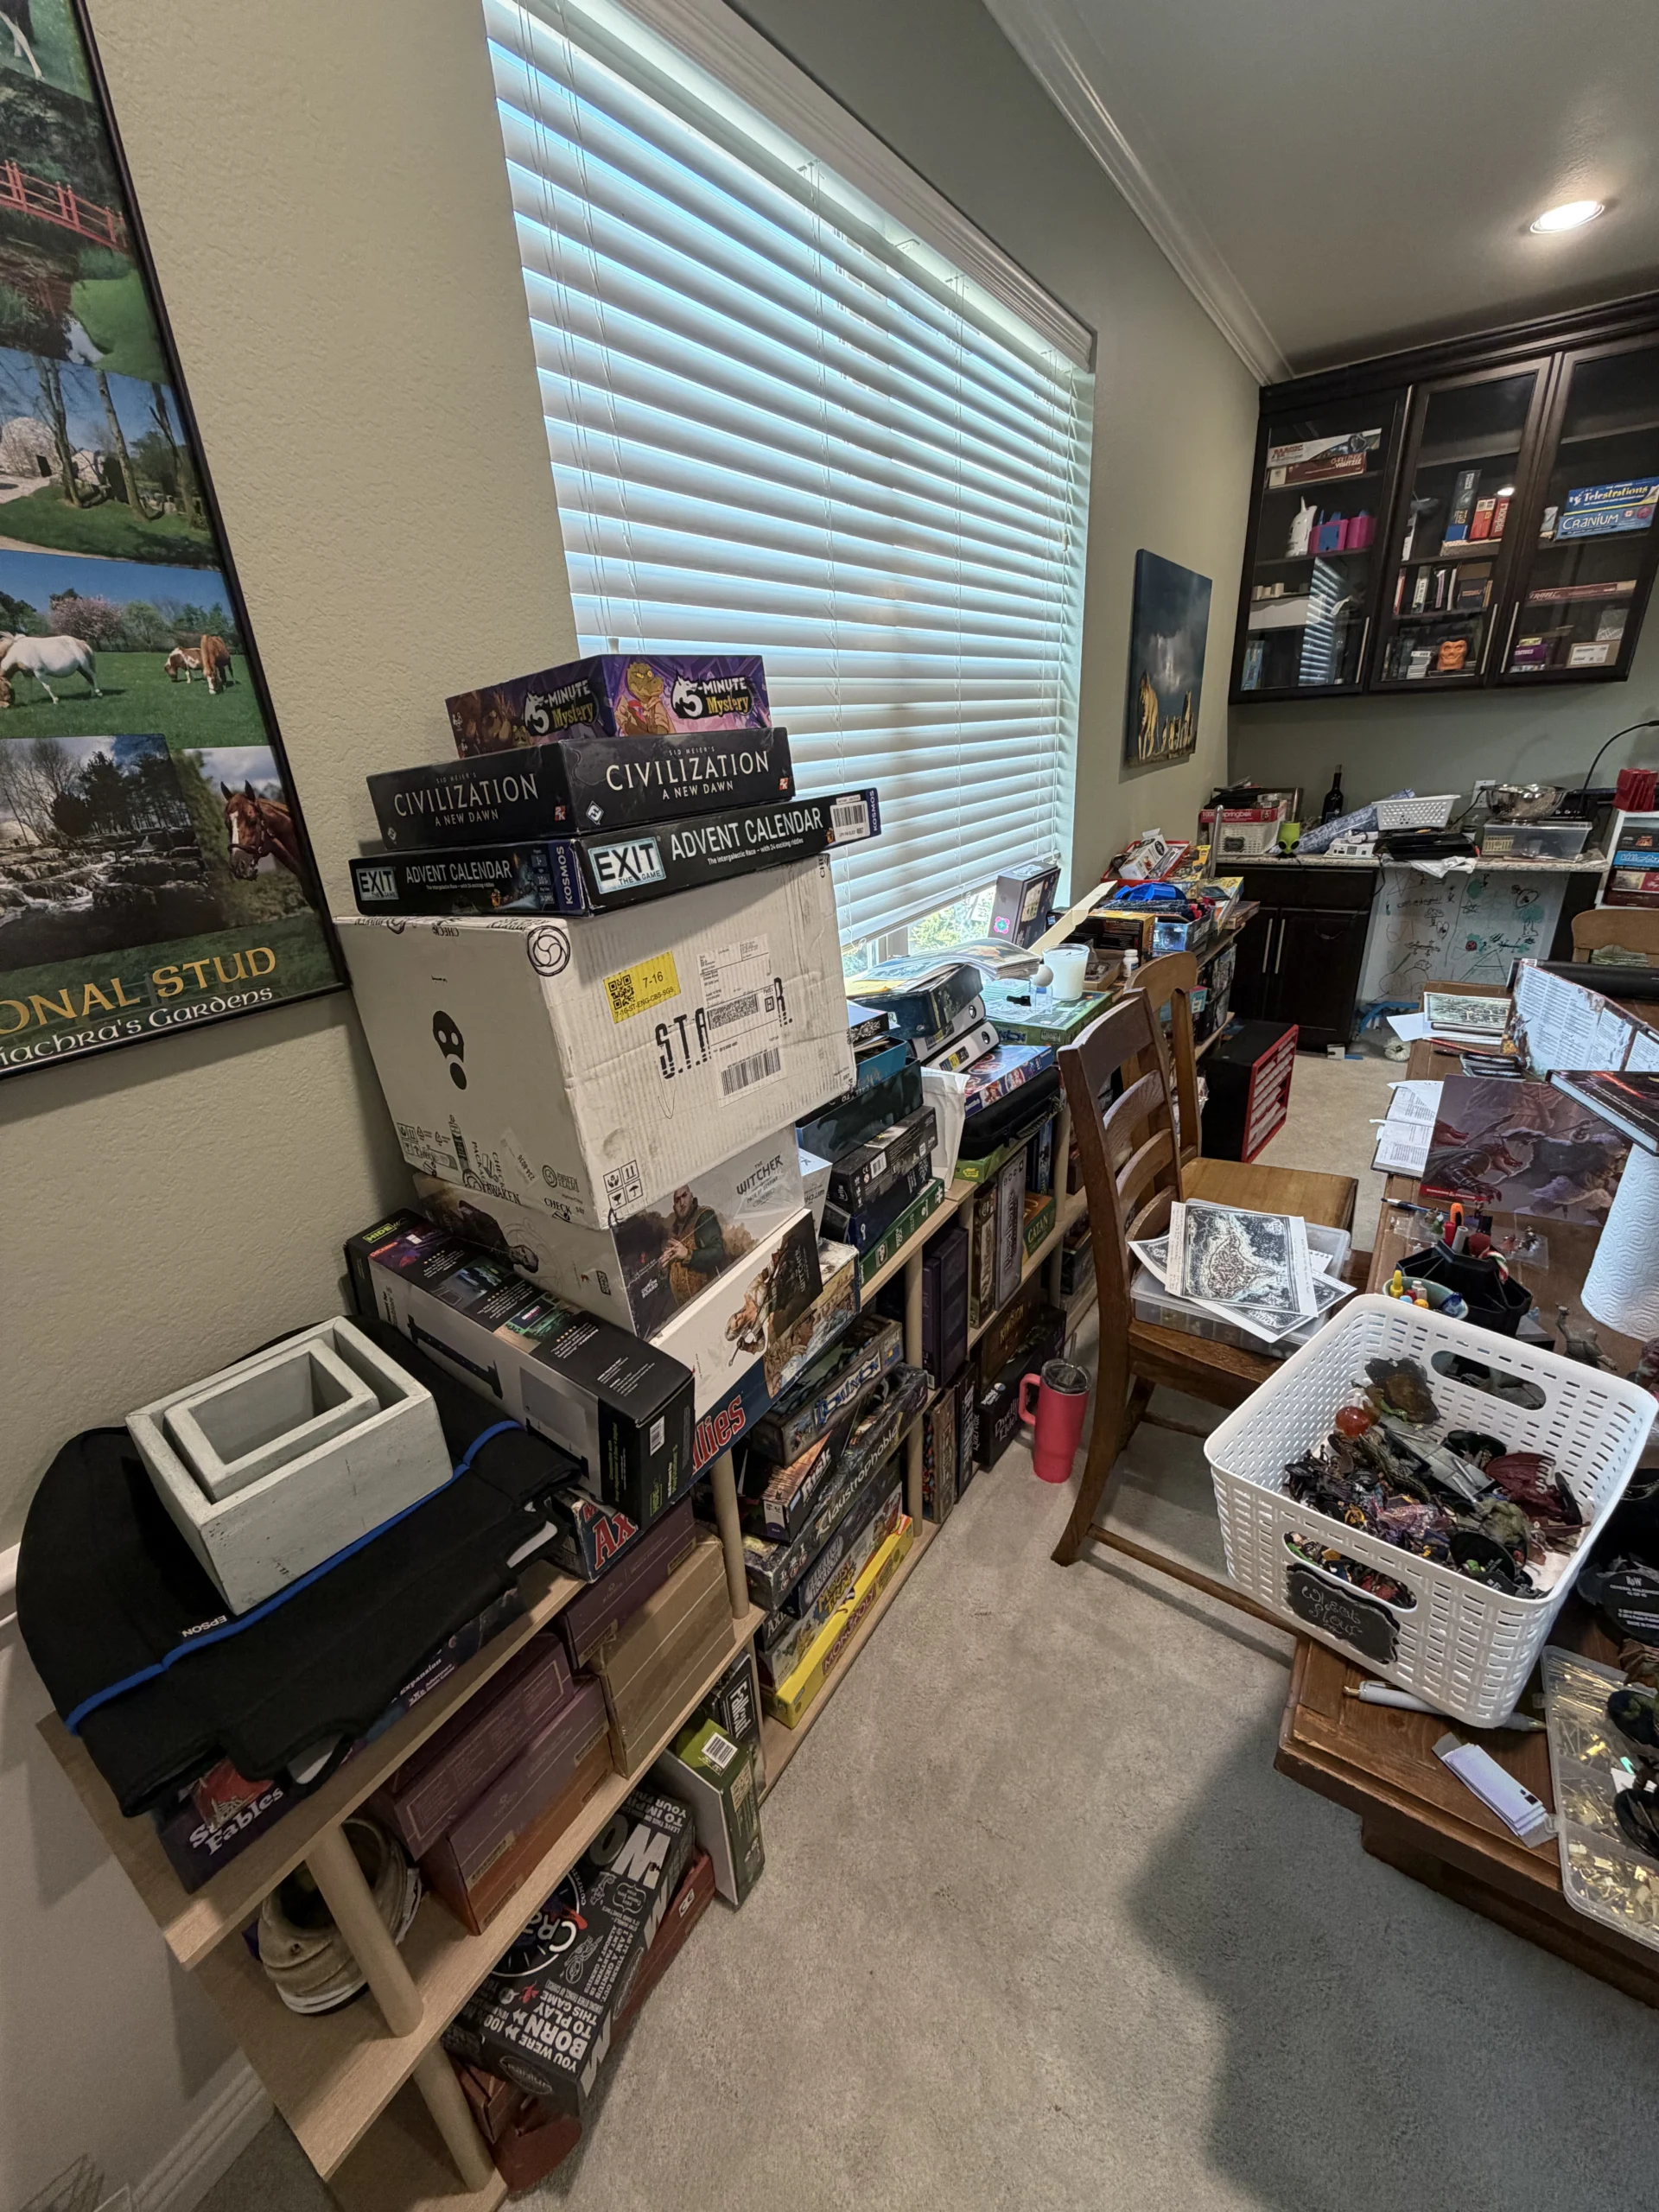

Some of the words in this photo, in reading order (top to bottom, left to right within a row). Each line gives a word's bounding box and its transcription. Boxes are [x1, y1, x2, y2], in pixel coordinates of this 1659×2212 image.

[1584, 486, 1649, 502] Telestrations
[550, 701, 594, 729] Mystery
[706, 695, 749, 715] Mystery
[606, 751, 769, 791] CIVILIZATION
[394, 773, 539, 817] CIVILIZATION
[663, 789, 670, 800] A
[674, 785, 698, 799] NEW
[703, 780, 734, 795] DAWN
[435, 817, 442, 827] A
[444, 812, 465, 825] NEW
[469, 809, 499, 823] DAWN
[869, 790, 878, 831] KOSMOS
[671, 822, 741, 861] ADVENT
[745, 807, 823, 844] CALENDAR
[406, 864, 447, 884] ADVENT
[450, 860, 513, 881] CALENDAR
[556, 846, 574, 905] KOSMOS
[598, 843, 656, 882] EXIT
[360, 868, 396, 897] EXIT
[152, 946, 276, 998] STUD
[642, 971, 664, 988] 7-16
[149, 987, 273, 1027] Gardens
[736, 1154, 784, 1196] WITCHER
[544, 1197, 572, 1216] CHECK
[366, 1224, 393, 1242] HIDE
[1027, 1214, 1049, 1243] CATAN
[818, 1555, 853, 1614] MOUSE
[824, 1568, 855, 1613] TRAP
[181, 1614, 227, 1638] EPSON
[730, 1681, 751, 1745] Fallout
[208, 1786, 284, 1856] Fables
[655, 1799, 687, 1819] YOUR
[664, 1815, 683, 1827] TO
[664, 1824, 681, 1834] LEAVE
[589, 1814, 671, 1891] WO
[594, 1962, 614, 1999] GENIUS
[539, 1990, 572, 2012] GAME
[533, 2002, 572, 2030] PLAY
[572, 2006, 598, 2026] THIS
[572, 2020, 592, 2039] TO
[518, 2033, 553, 2061] WERE
[524, 2013, 588, 2060] BORN
[553, 2052, 577, 2073] YOU
